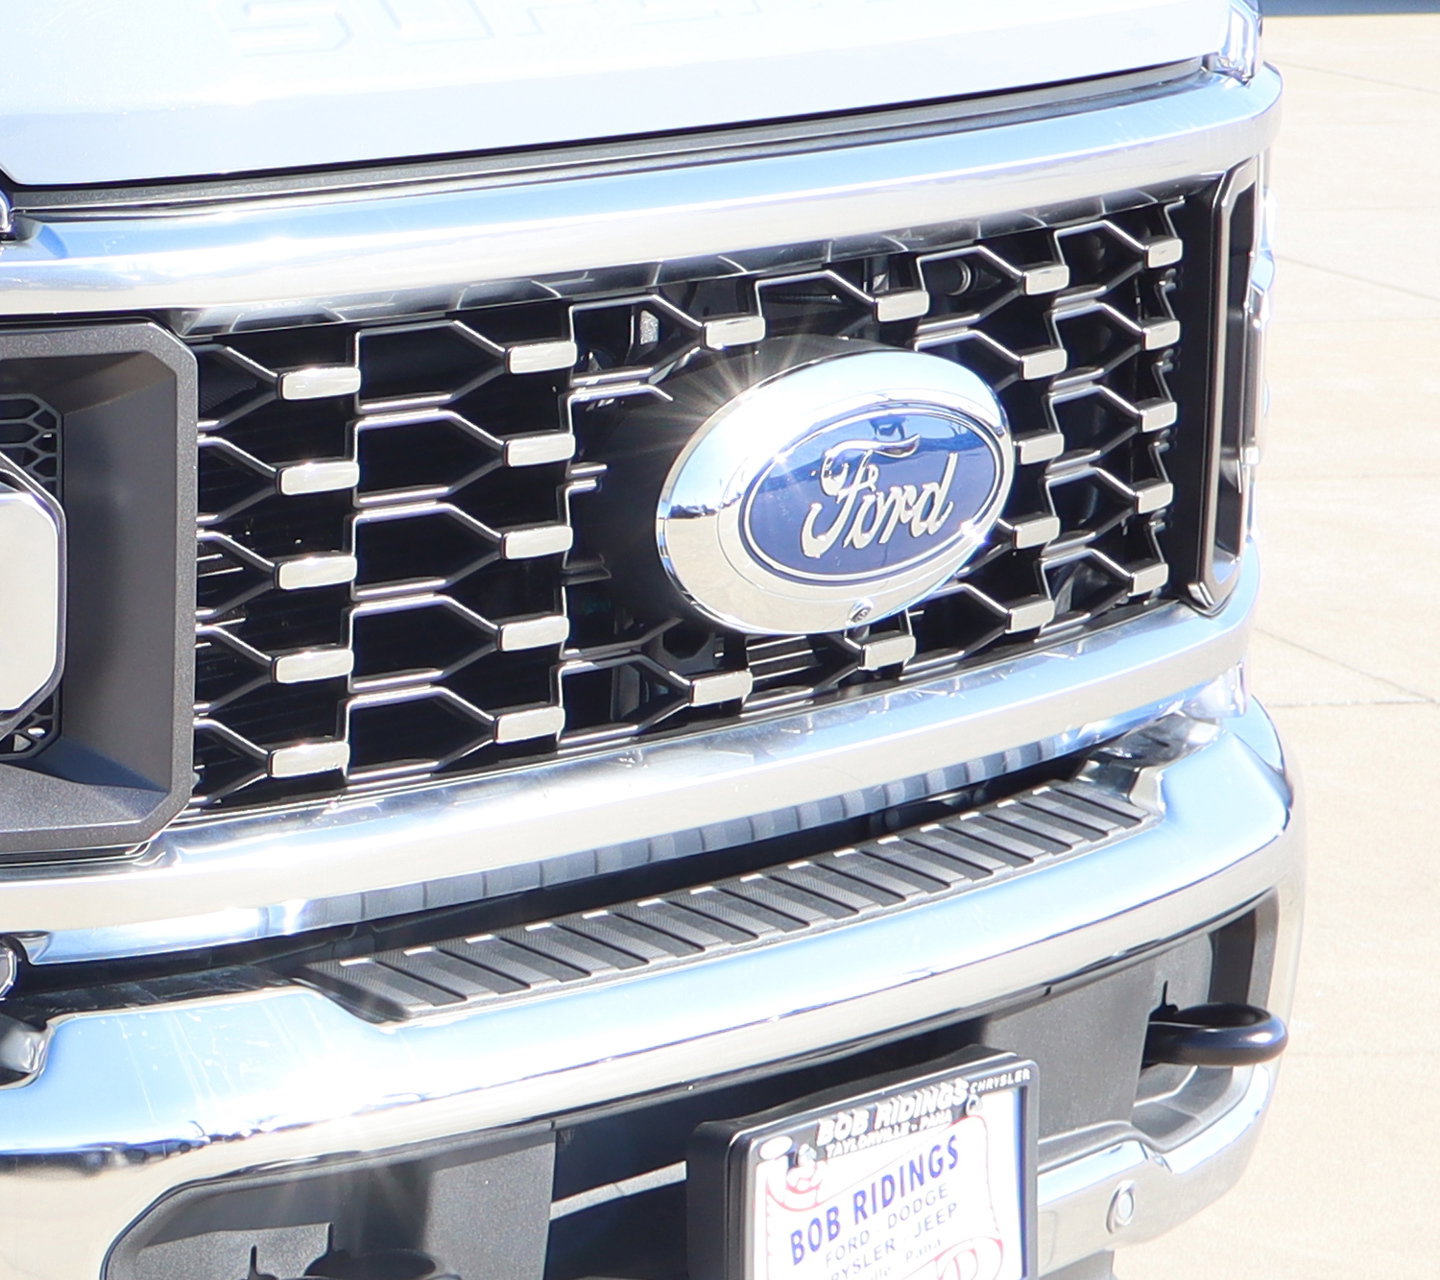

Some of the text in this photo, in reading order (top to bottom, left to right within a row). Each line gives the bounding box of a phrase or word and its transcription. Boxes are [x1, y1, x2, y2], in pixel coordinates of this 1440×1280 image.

[800, 433, 958, 558] Ford
[816, 1077, 970, 1147] BOB RIDINGS
[970, 1067, 1031, 1095] CHRYSLER
[790, 1133, 960, 1266] BOB RIDINGS
[825, 1181, 950, 1268] FORD DODGE
[913, 1201, 958, 1239] JEEP
